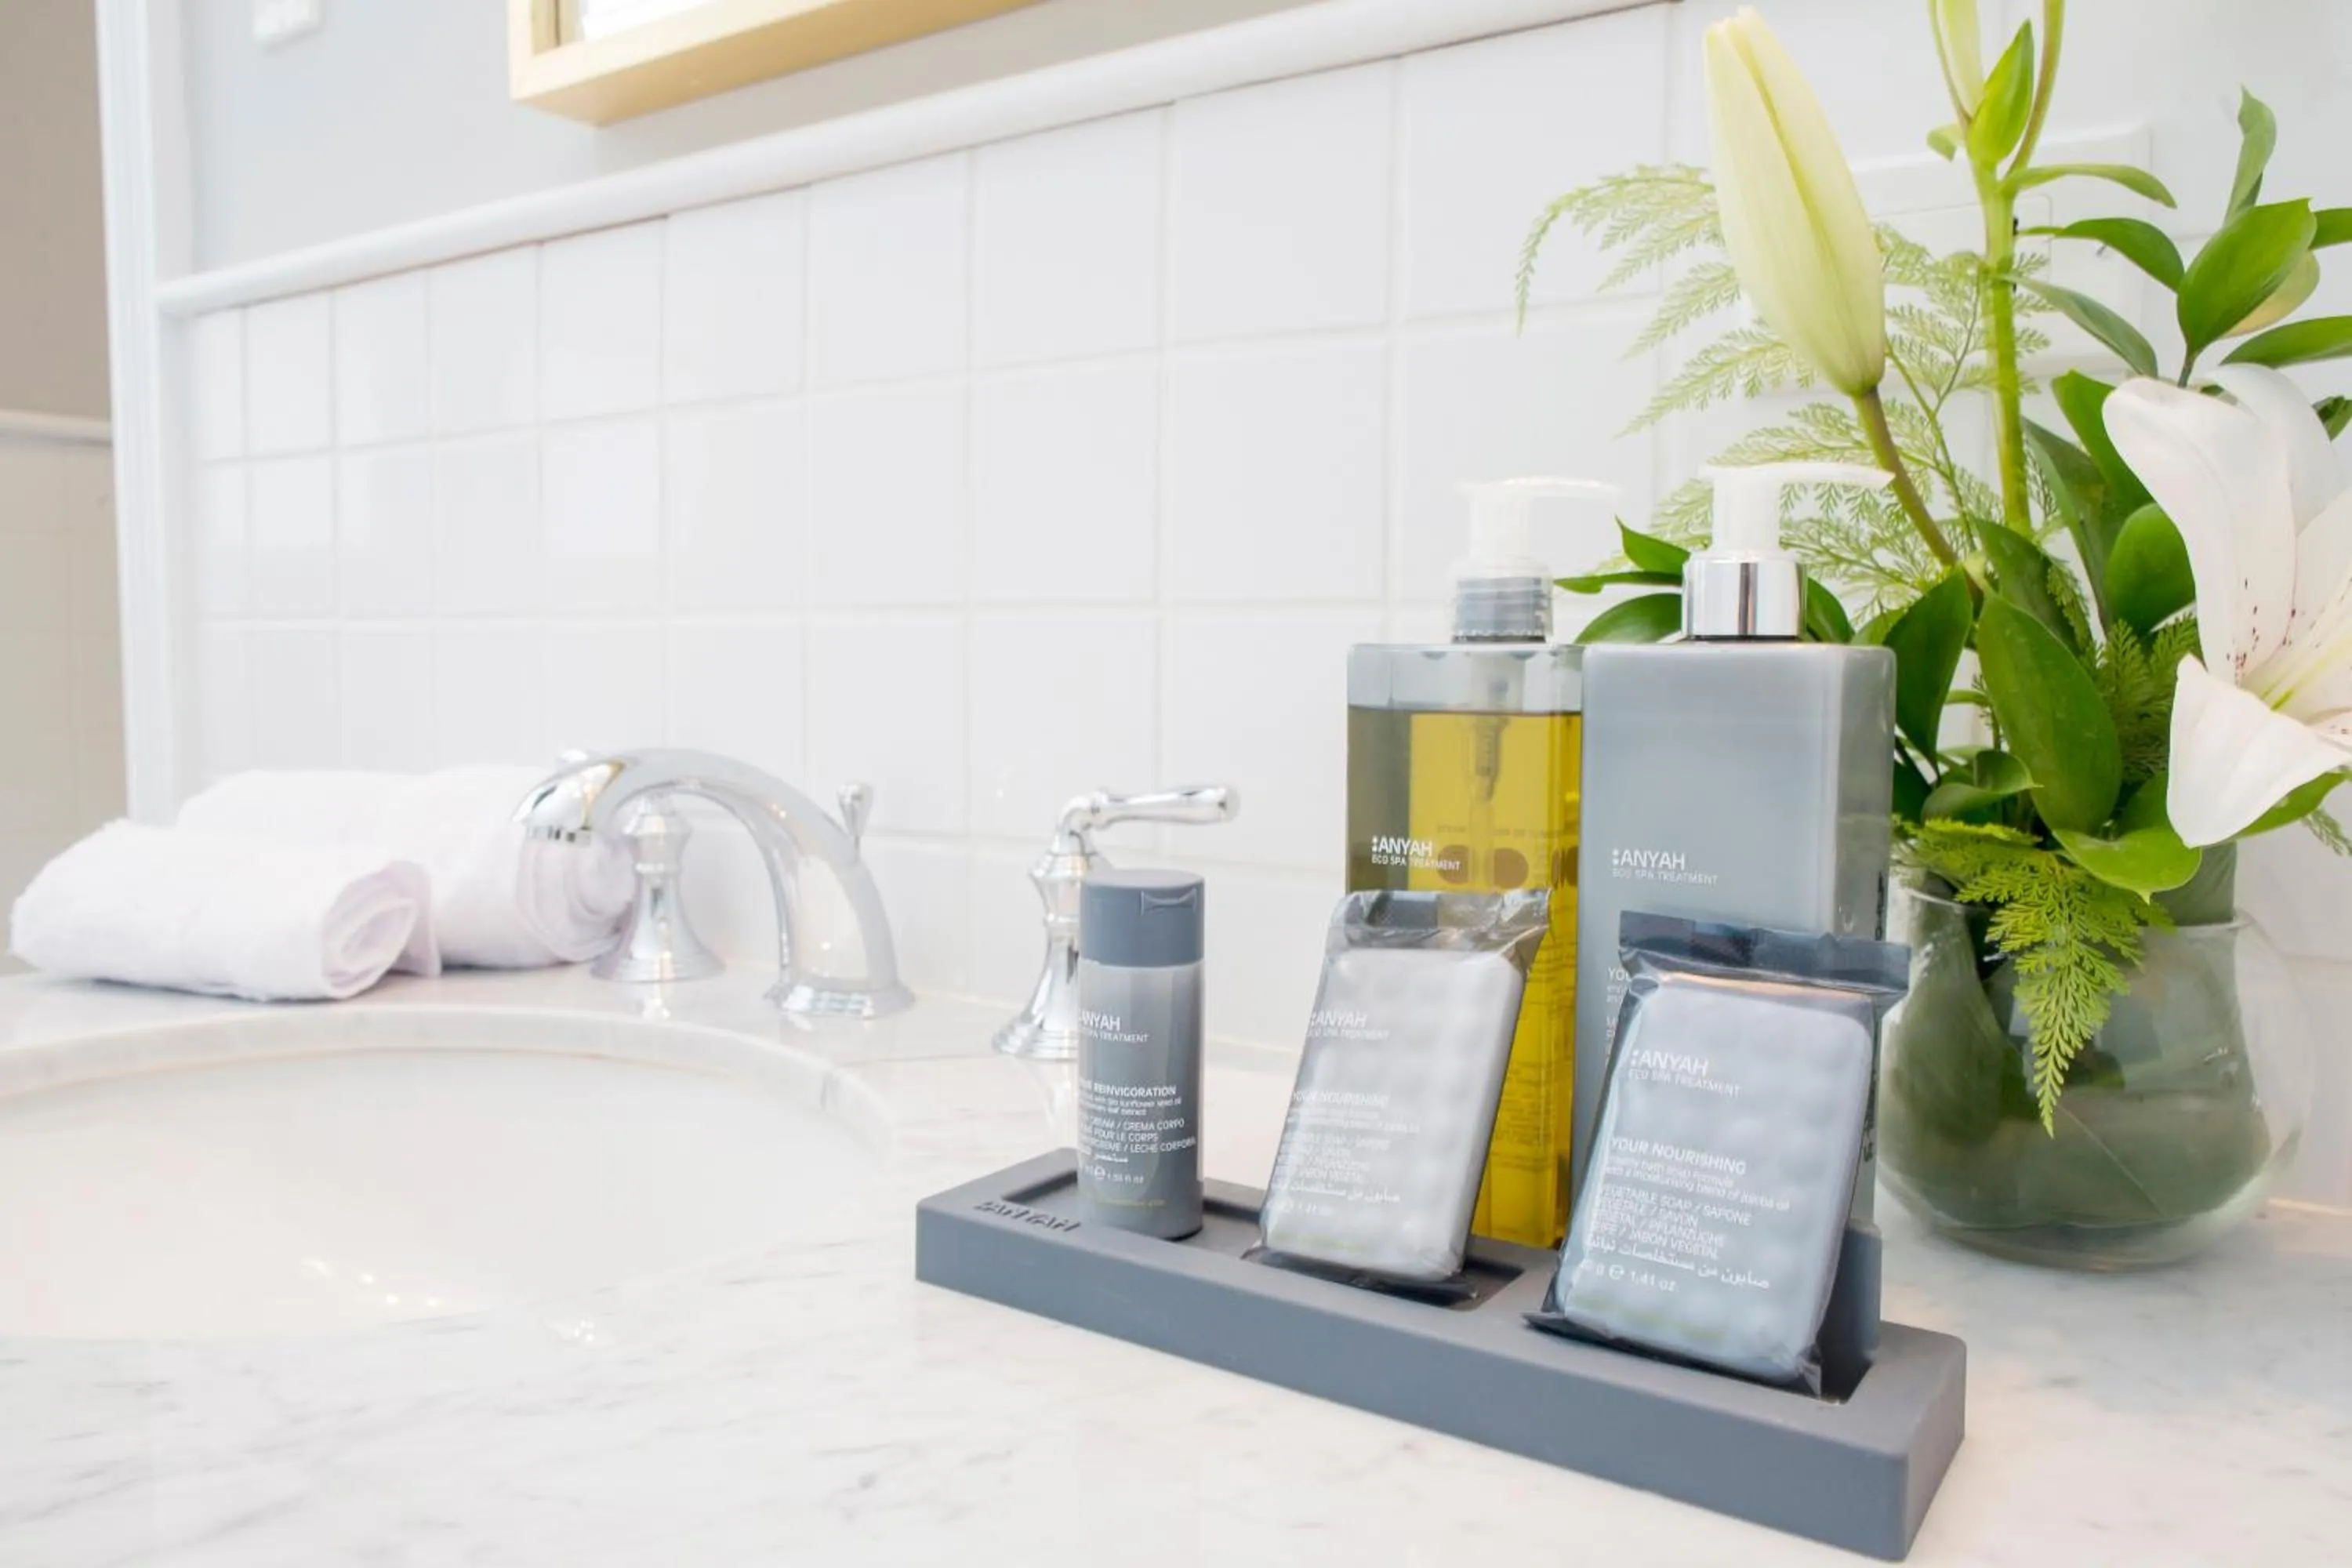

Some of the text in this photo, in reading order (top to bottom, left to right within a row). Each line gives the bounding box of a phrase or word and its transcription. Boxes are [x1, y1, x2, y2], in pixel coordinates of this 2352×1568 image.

[1372, 855, 1460, 871] ECO SPA TREATMENT
[1657, 872, 1718, 886] TREATMENT
[1094, 1082, 1177, 1098] REINVIGORATION
[1611, 1138, 1649, 1155] YOUR
[1652, 1143, 1747, 1175] NOURISHING
